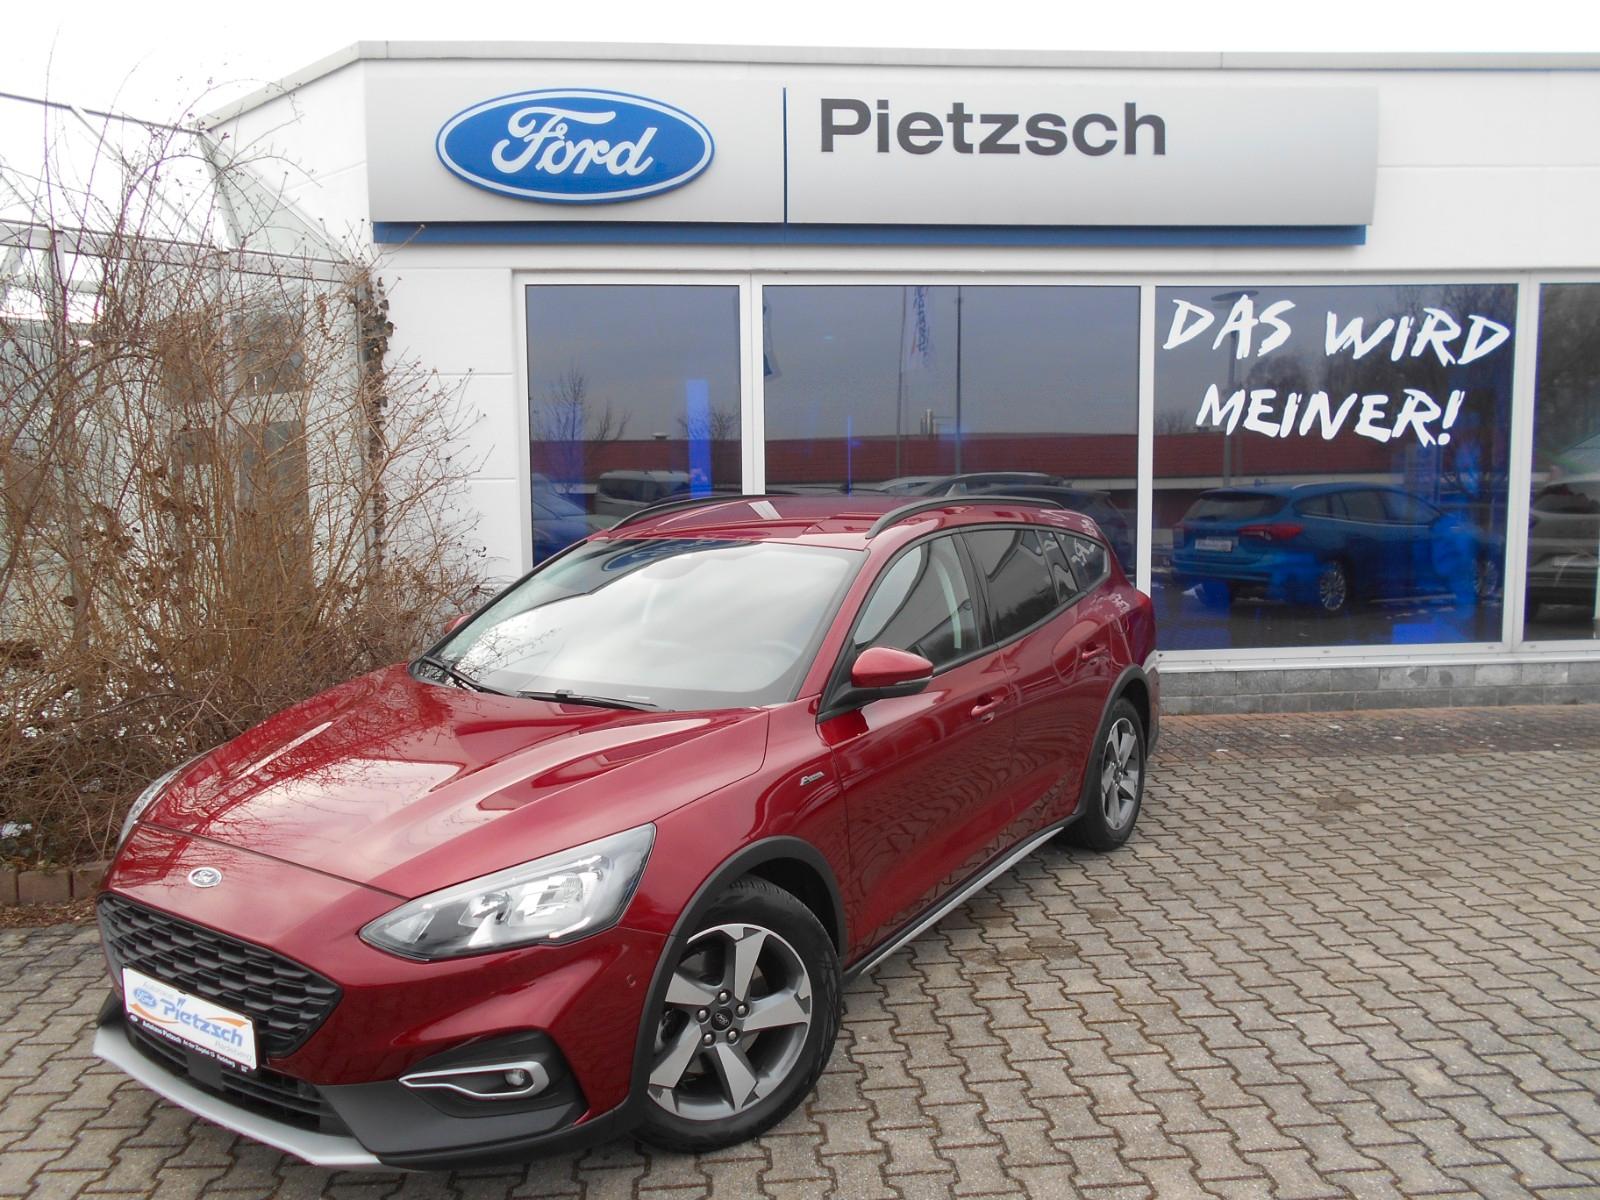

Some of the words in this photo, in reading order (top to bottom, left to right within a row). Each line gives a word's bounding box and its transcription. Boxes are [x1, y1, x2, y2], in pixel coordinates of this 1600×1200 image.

[492, 106, 657, 176] Ford
[822, 99, 1166, 157] Pietzsch
[1163, 294, 1296, 360] DAS
[1325, 307, 1510, 367] WIRD
[1196, 383, 1465, 447] MEINER!
[159, 998, 243, 1047] Pietzsch
